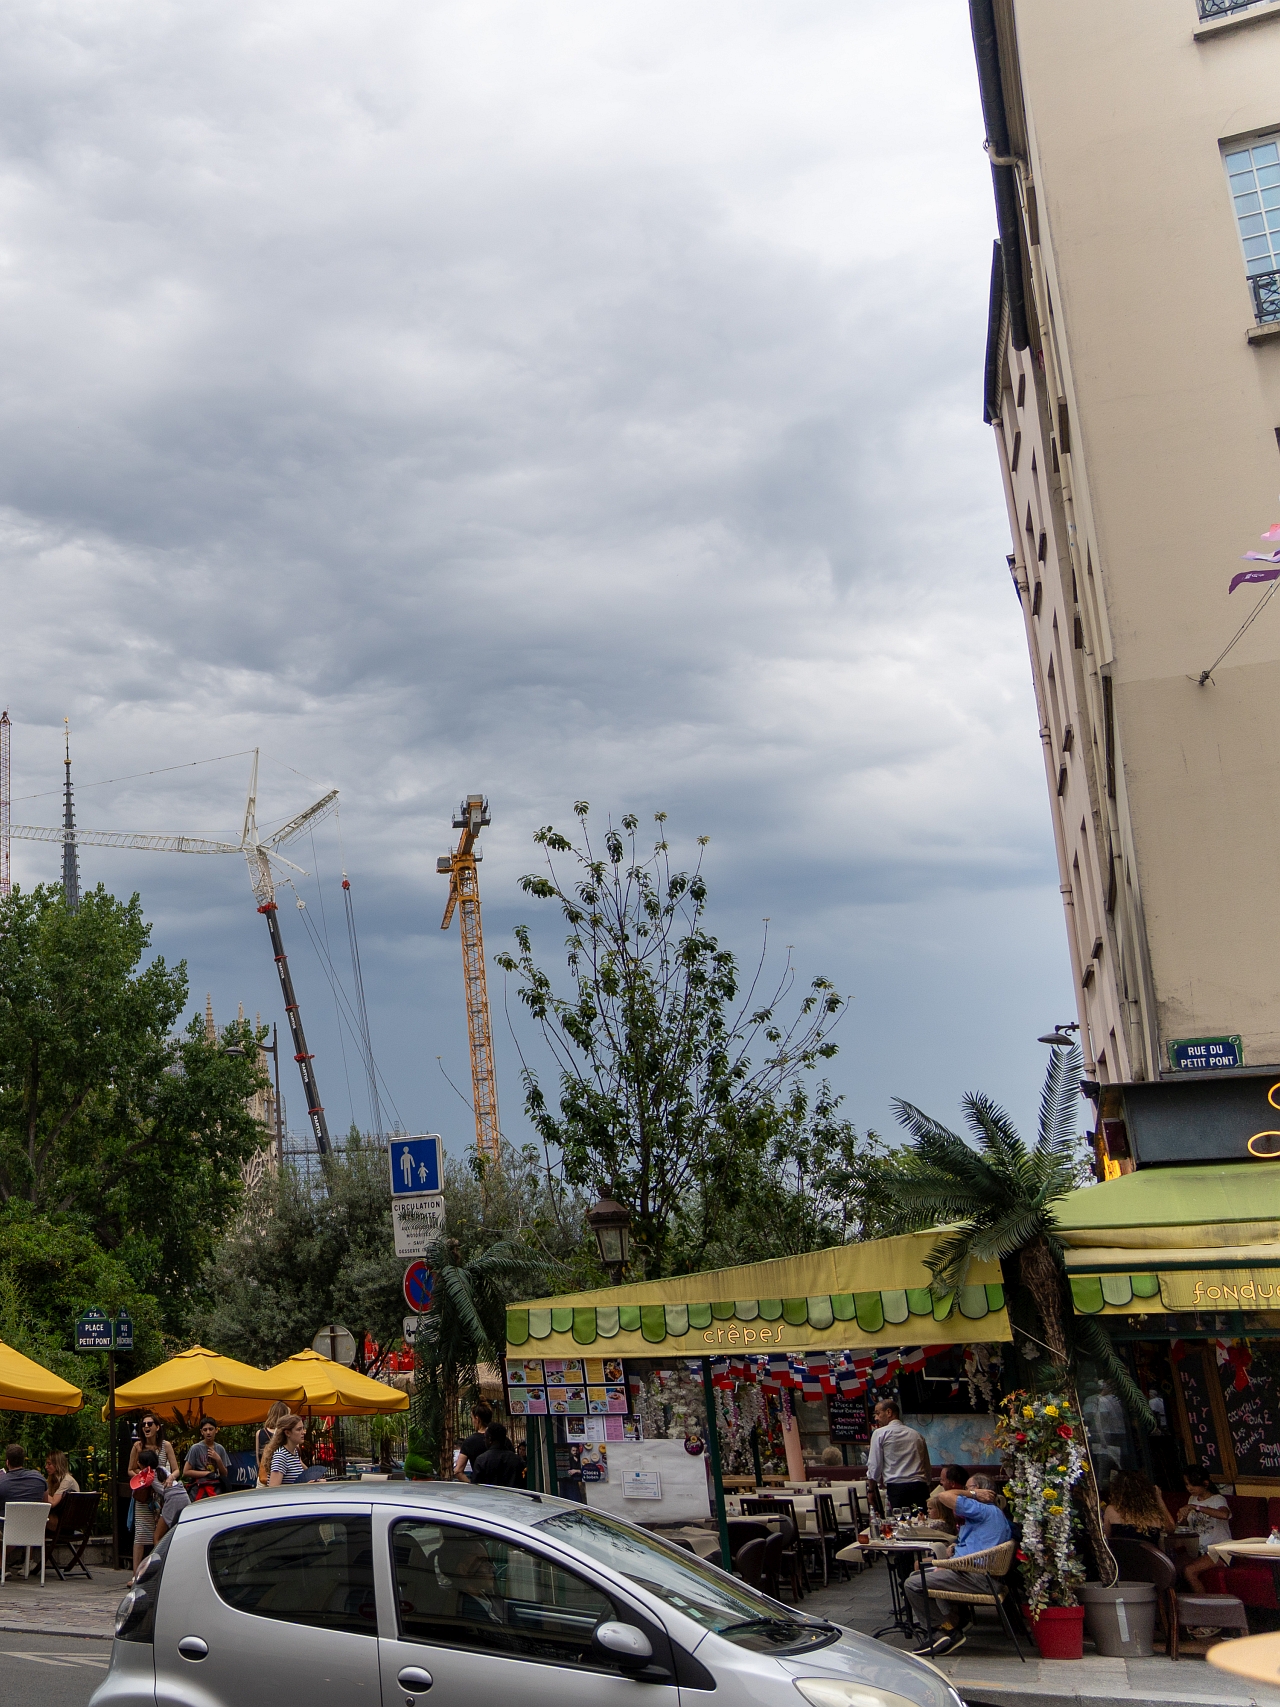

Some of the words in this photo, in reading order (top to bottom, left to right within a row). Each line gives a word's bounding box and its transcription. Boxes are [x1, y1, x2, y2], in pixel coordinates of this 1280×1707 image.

[1187, 1045, 1207, 1056] RUE
[1209, 1044, 1223, 1054] DU
[1180, 1057, 1206, 1068] PETIT
[1209, 1056, 1234, 1066] PONT
[393, 1200, 441, 1211] CIRCULATION
[84, 1323, 105, 1332] PLACE
[702, 1322, 786, 1346] crêpes
[79, 1337, 95, 1345] PETIT
[95, 1337, 111, 1345] PONT
